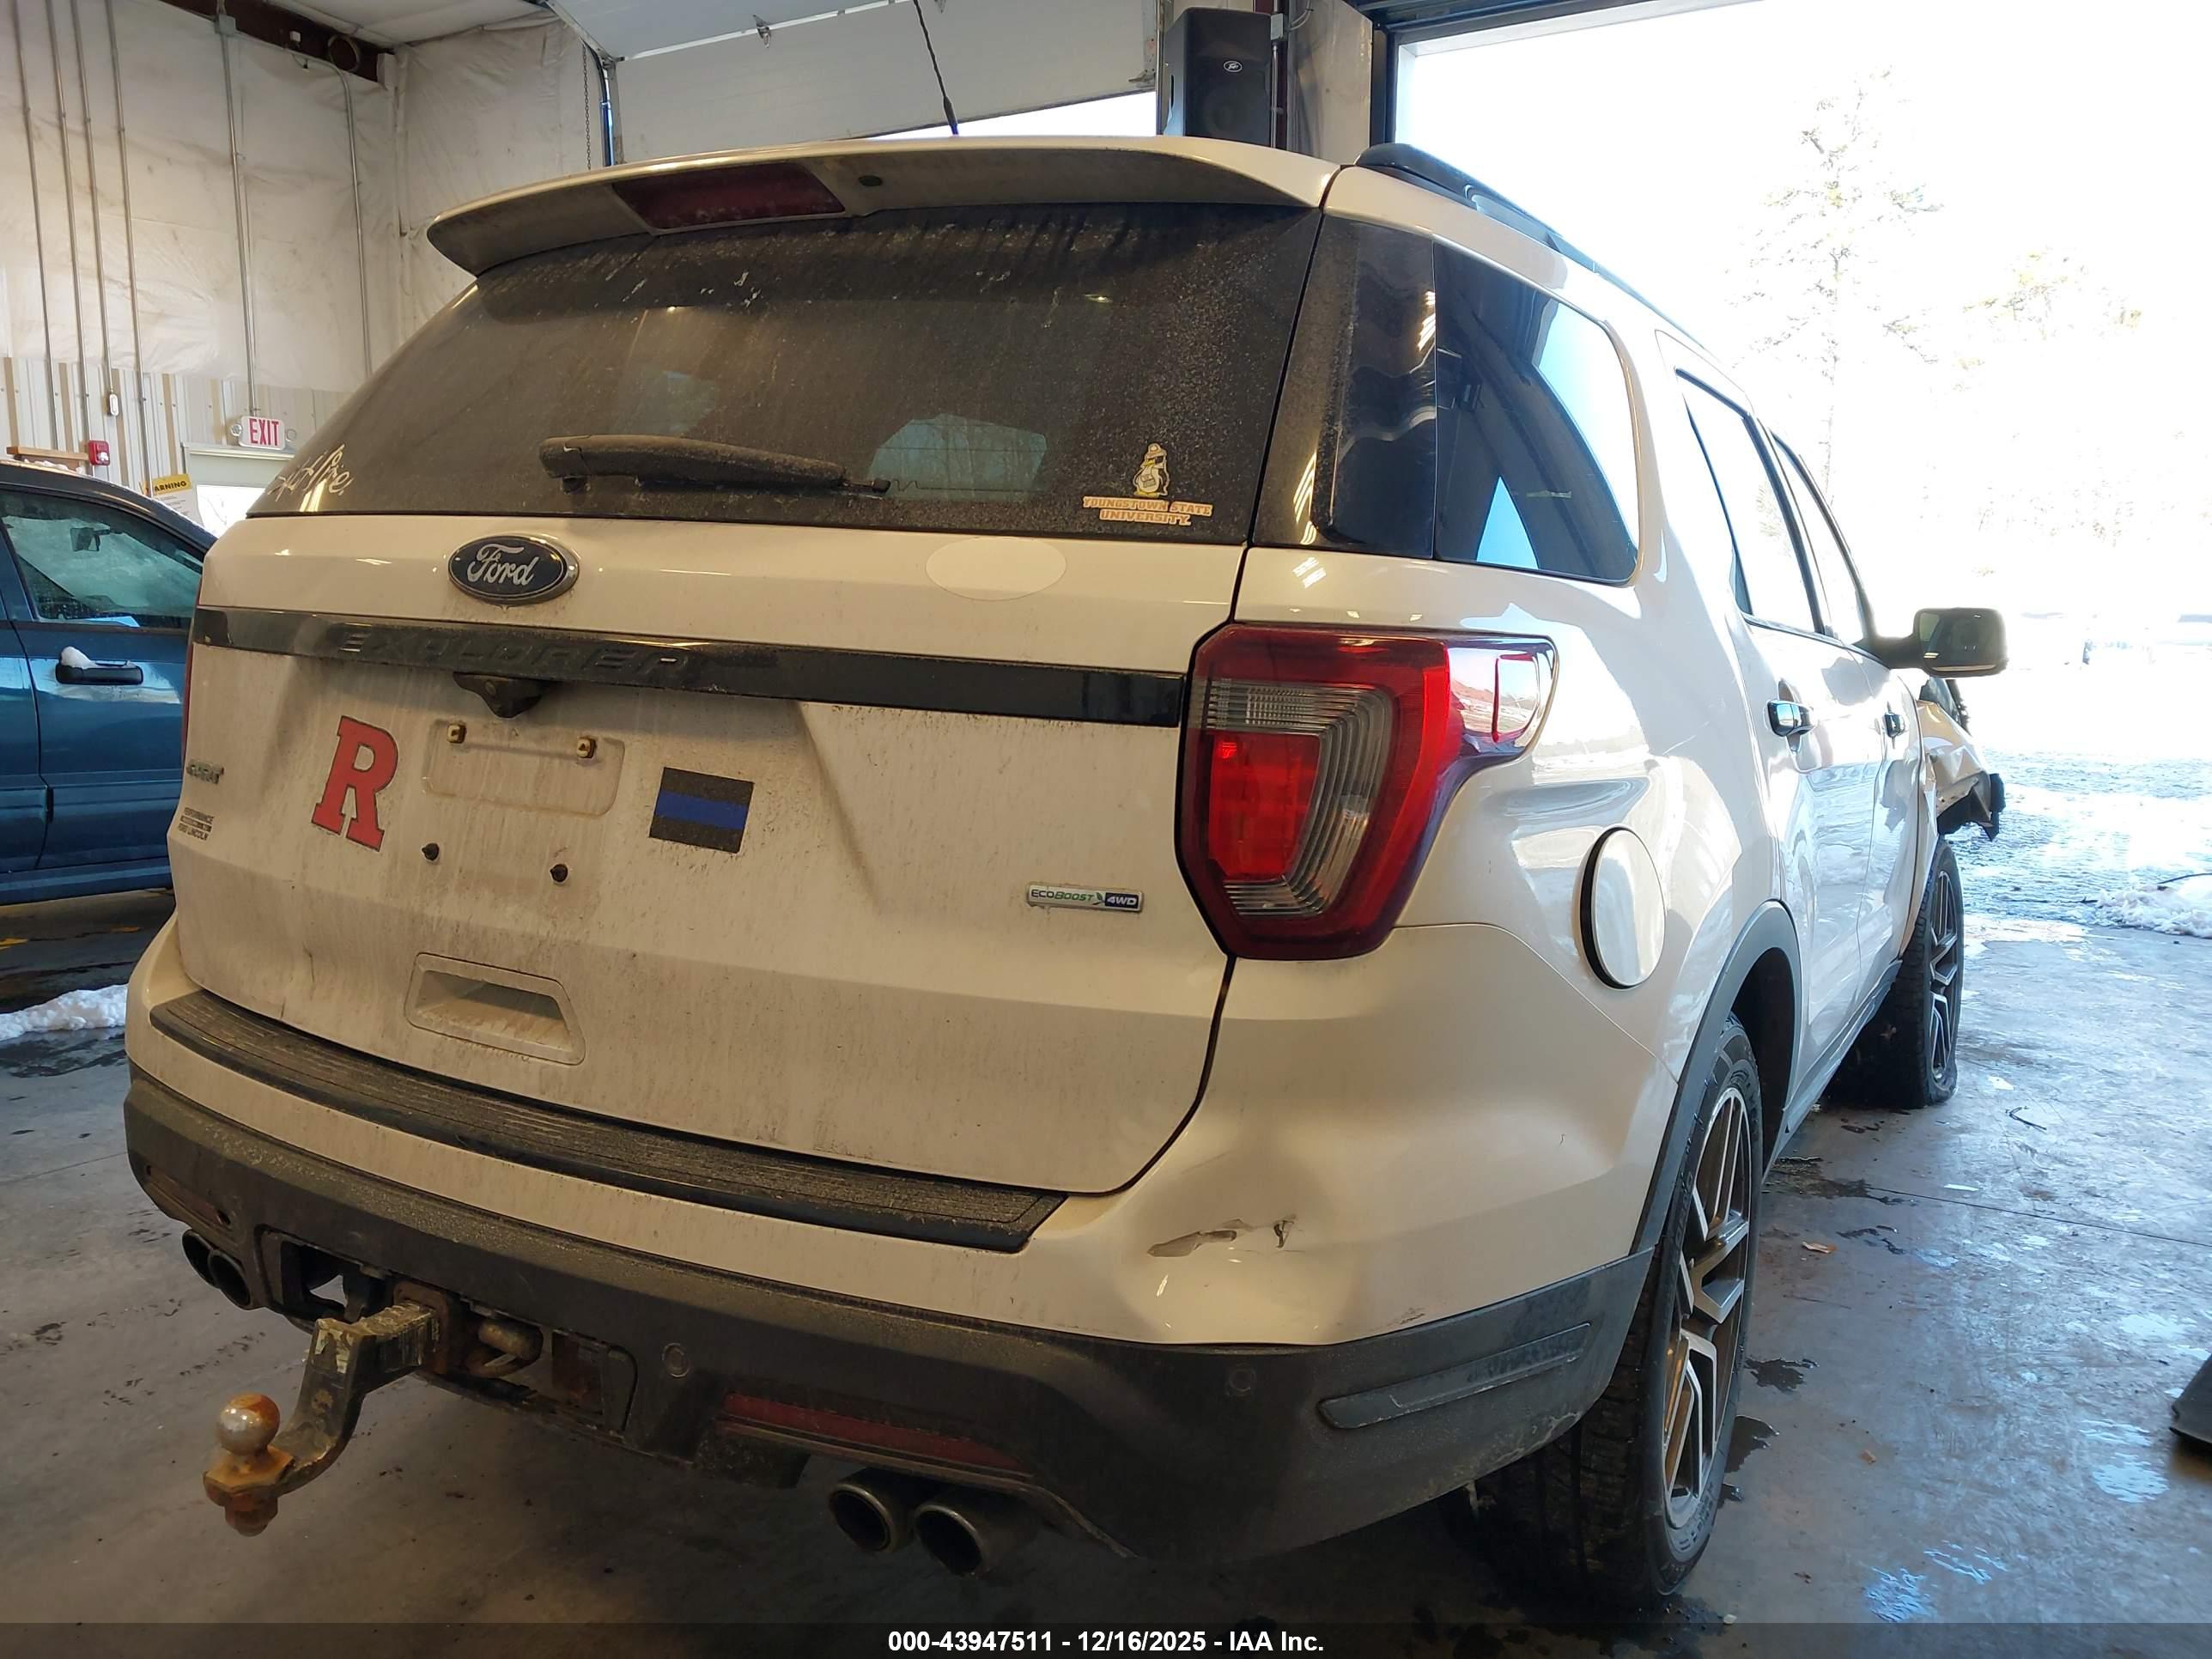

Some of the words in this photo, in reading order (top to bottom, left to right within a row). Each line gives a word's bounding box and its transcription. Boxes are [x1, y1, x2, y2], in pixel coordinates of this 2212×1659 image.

[248, 417, 279, 447] EXIT
[1083, 496, 1169, 513] YOUNGSTOWN
[1170, 501, 1212, 517] STATE
[1099, 509, 1191, 526] UNIVERSITY
[467, 543, 540, 586] Ford
[338, 629, 688, 680] EXPLORER
[311, 715, 398, 852] R
[1031, 889, 1094, 902] ECOBOOST
[1107, 896, 1137, 906] 4WD
